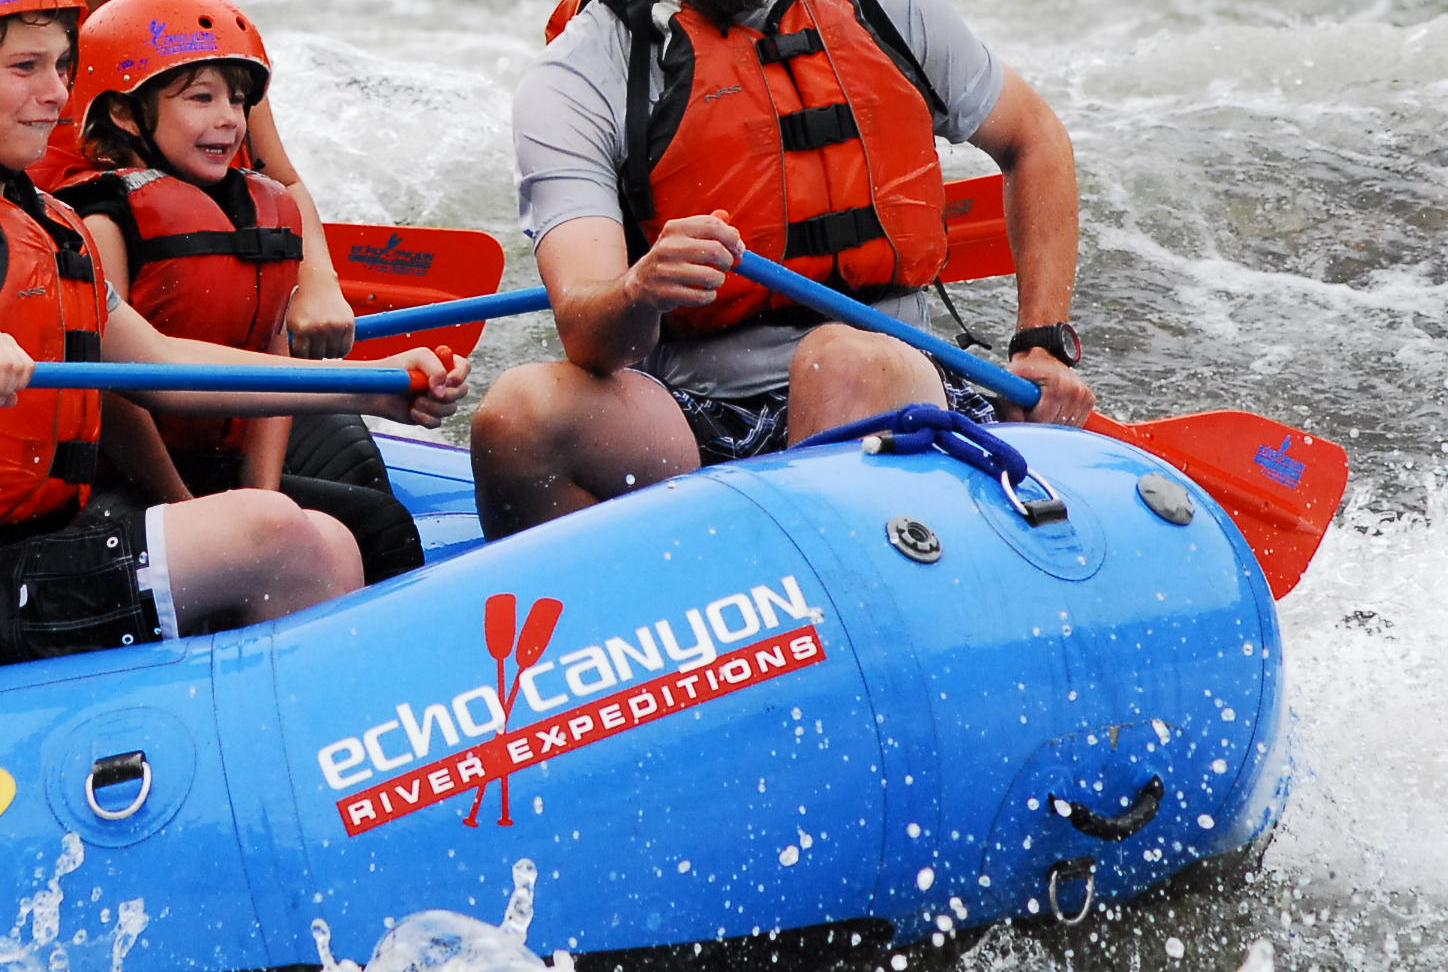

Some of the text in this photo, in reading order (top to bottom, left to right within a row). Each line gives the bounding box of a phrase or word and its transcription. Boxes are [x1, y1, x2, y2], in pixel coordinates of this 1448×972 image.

[318, 685, 507, 790] echo
[347, 634, 818, 826] RIVER EXPEDITIONS
